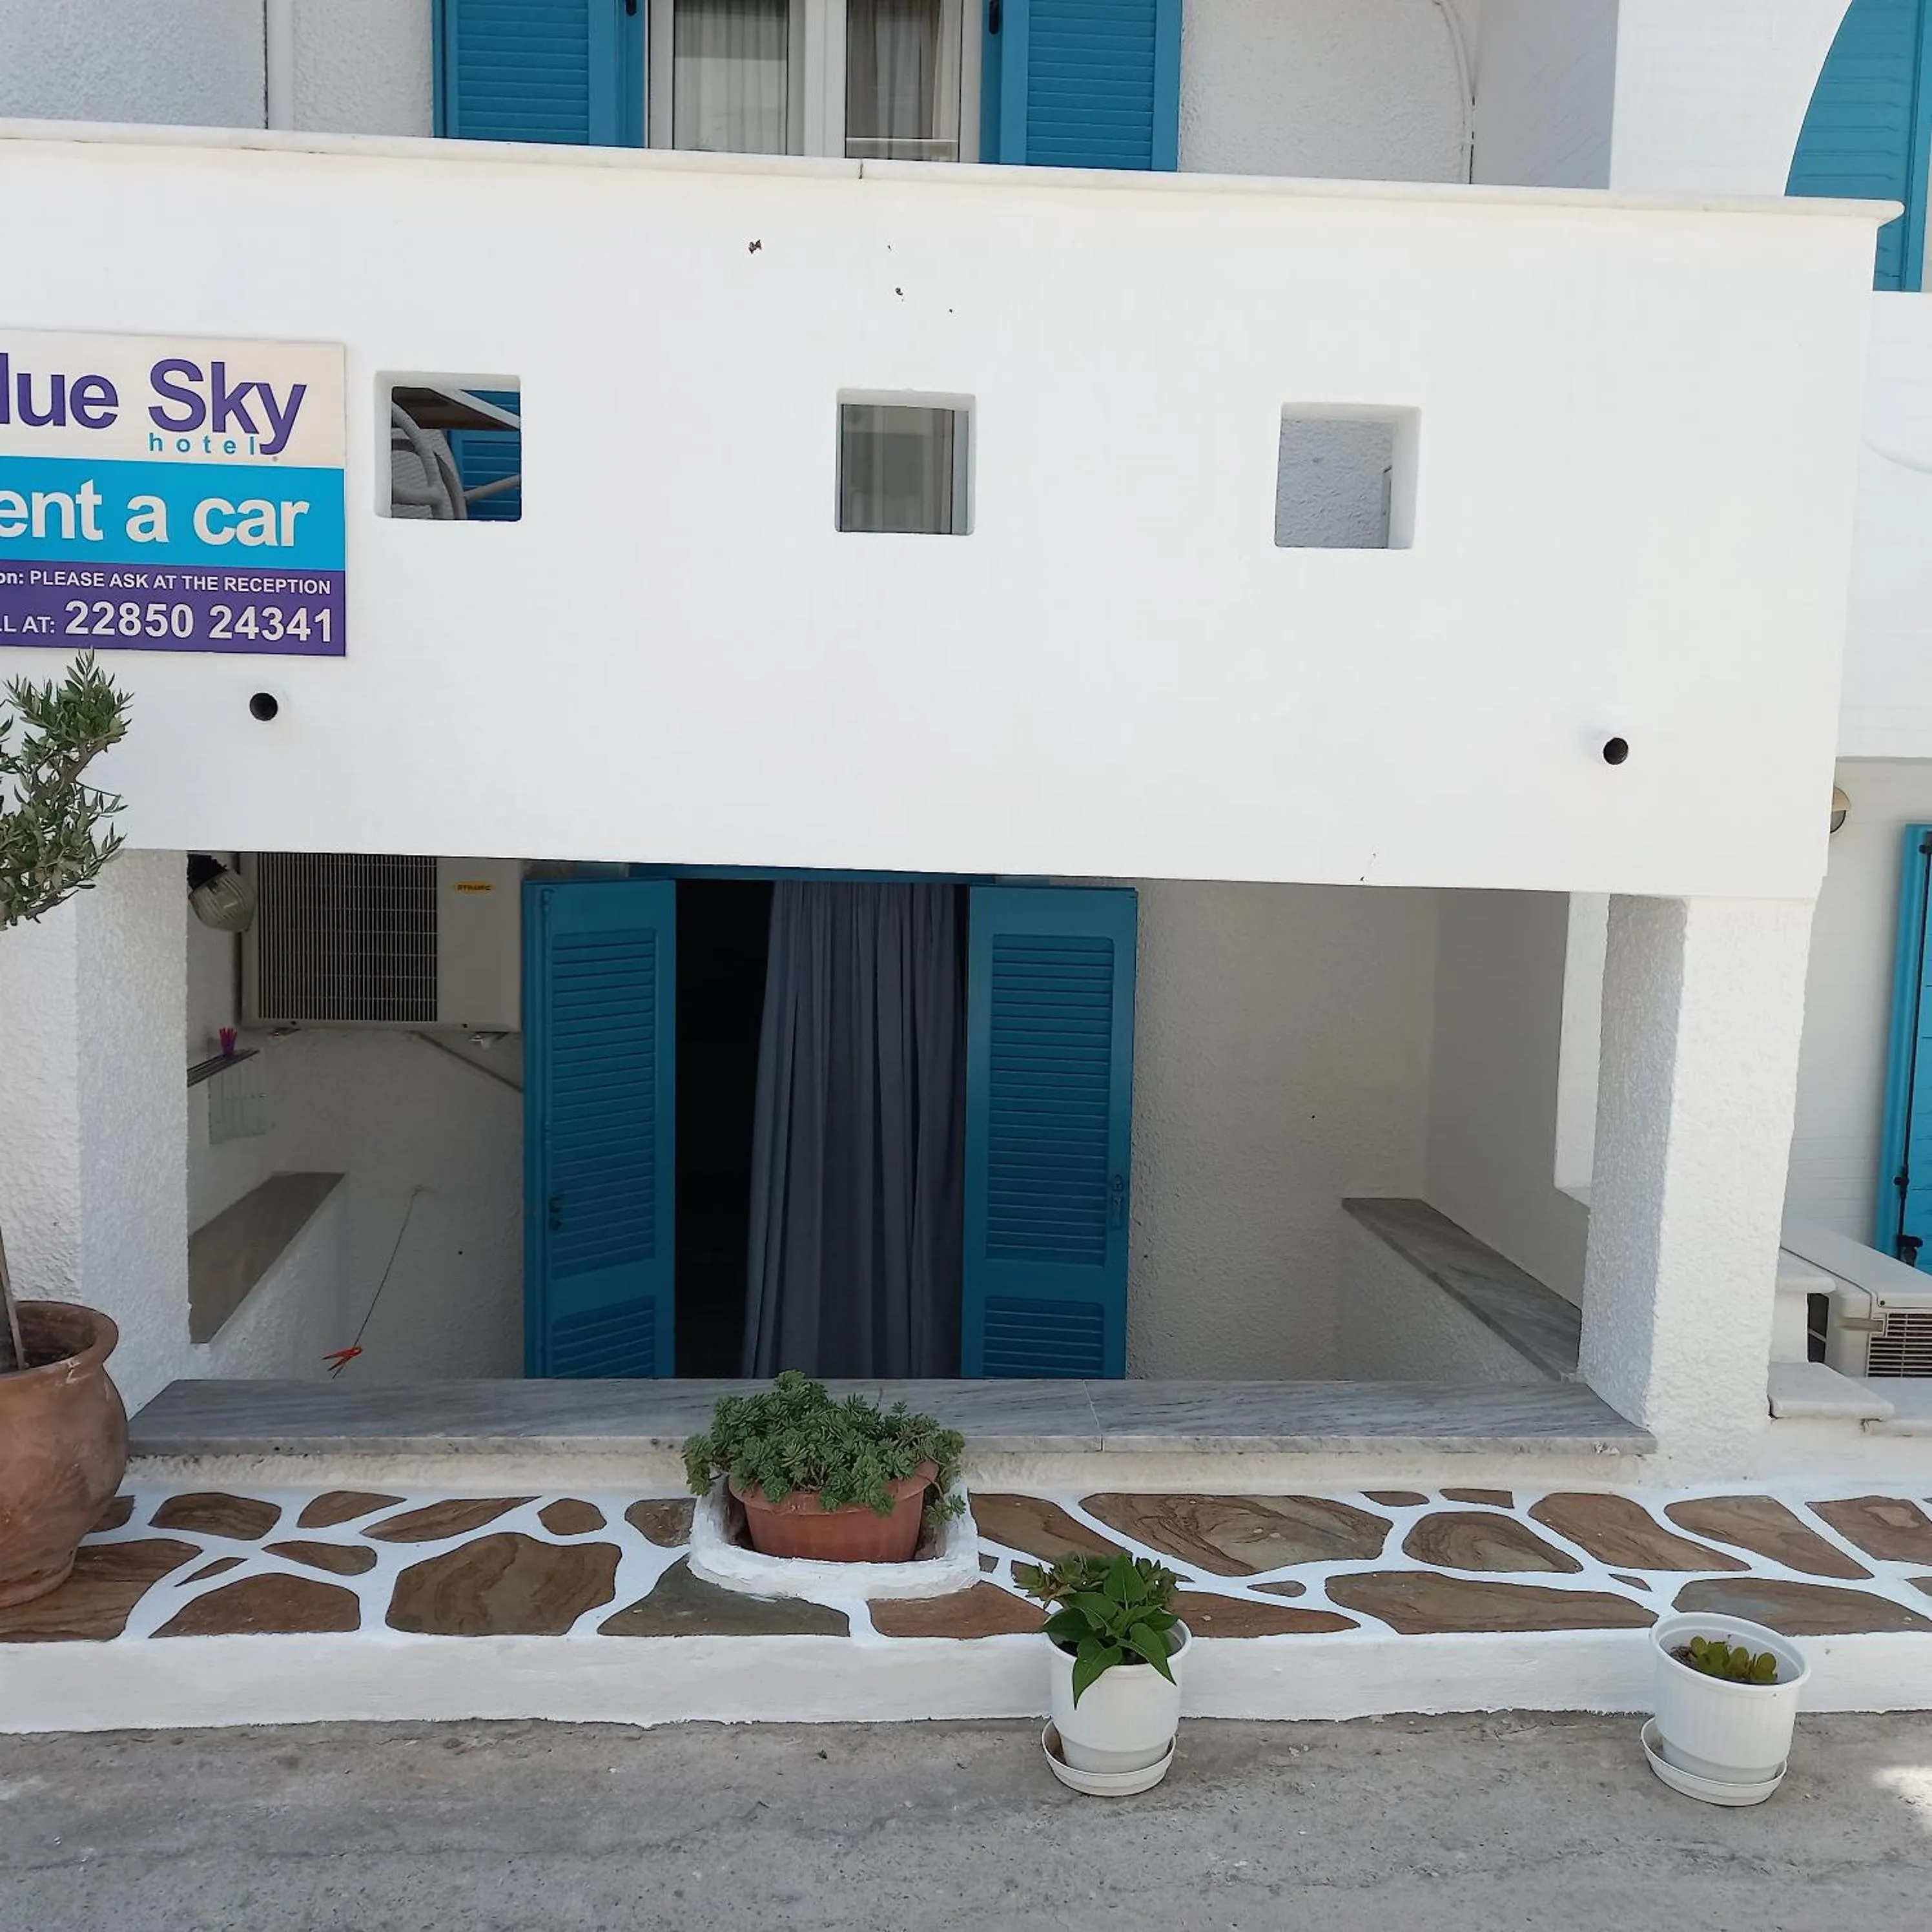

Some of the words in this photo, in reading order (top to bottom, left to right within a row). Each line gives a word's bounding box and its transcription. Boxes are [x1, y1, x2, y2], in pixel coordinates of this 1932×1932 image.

[149, 359, 307, 455] Sky
[149, 433, 255, 455] hotel
[126, 496, 169, 542] a
[194, 498, 310, 546] car
[30, 570, 105, 587] PLEASE
[109, 573, 149, 588] ASK
[153, 575, 177, 589] AT
[181, 575, 218, 591] THE
[224, 577, 331, 594] RECEPTION
[22, 615, 55, 633] AT:
[65, 601, 194, 638] 22850
[209, 605, 331, 642] 24341
